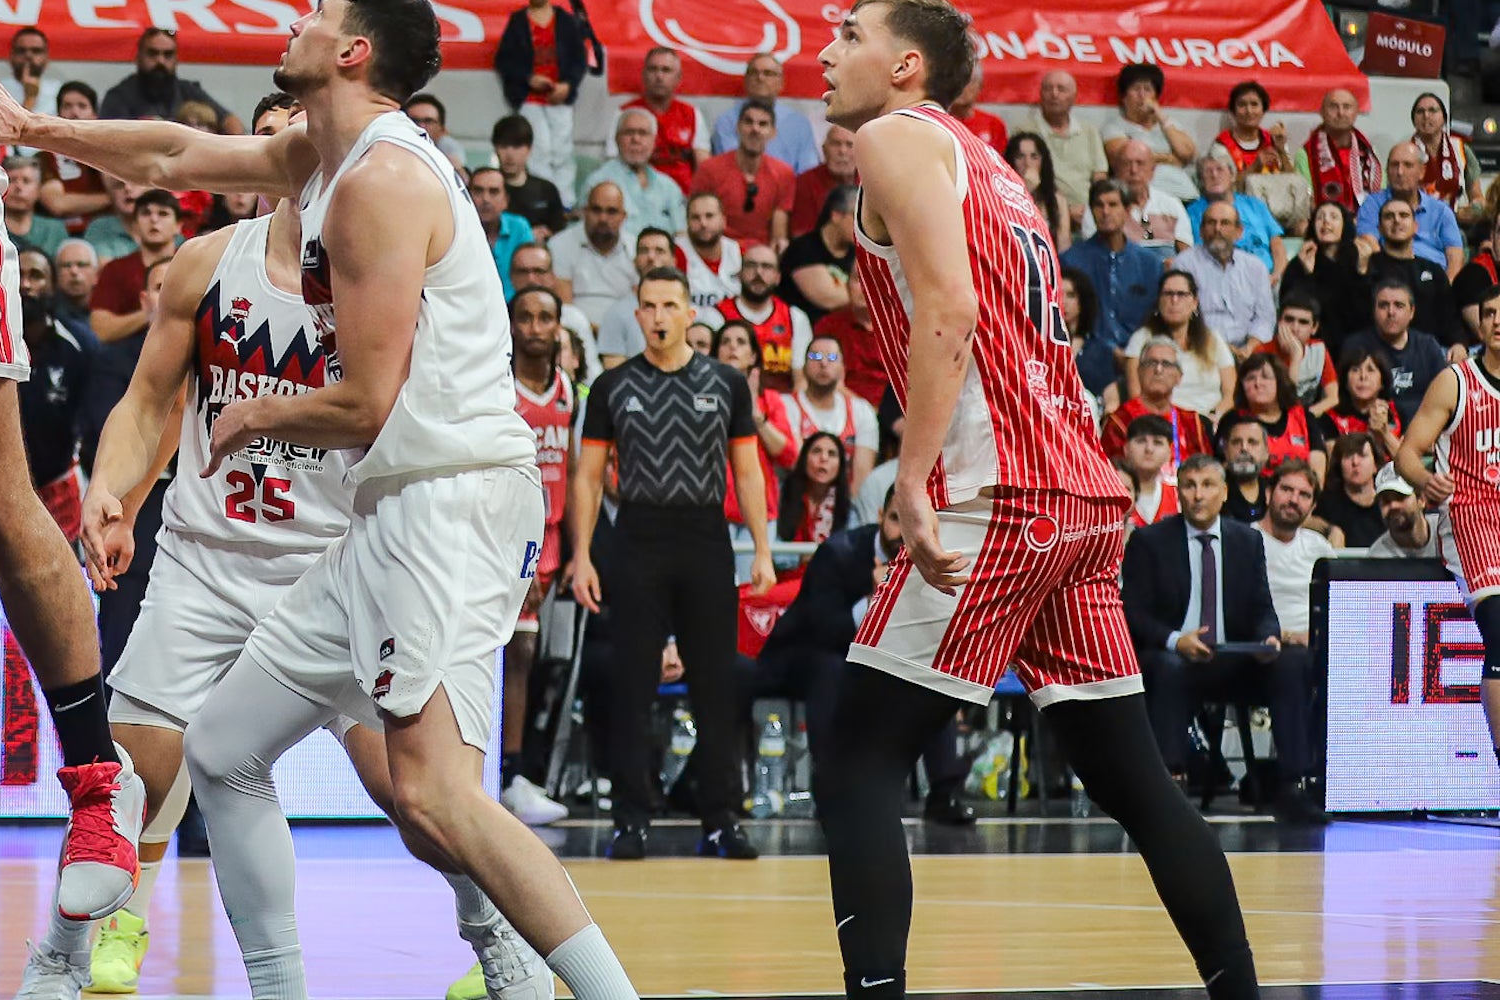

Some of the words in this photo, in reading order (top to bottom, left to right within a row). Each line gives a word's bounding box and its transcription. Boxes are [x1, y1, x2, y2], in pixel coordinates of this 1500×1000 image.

[1032, 31, 1103, 63] DE
[1108, 37, 1305, 69] MURCIA
[1376, 33, 1433, 58] MÓDULO
[226, 470, 296, 523] 25
